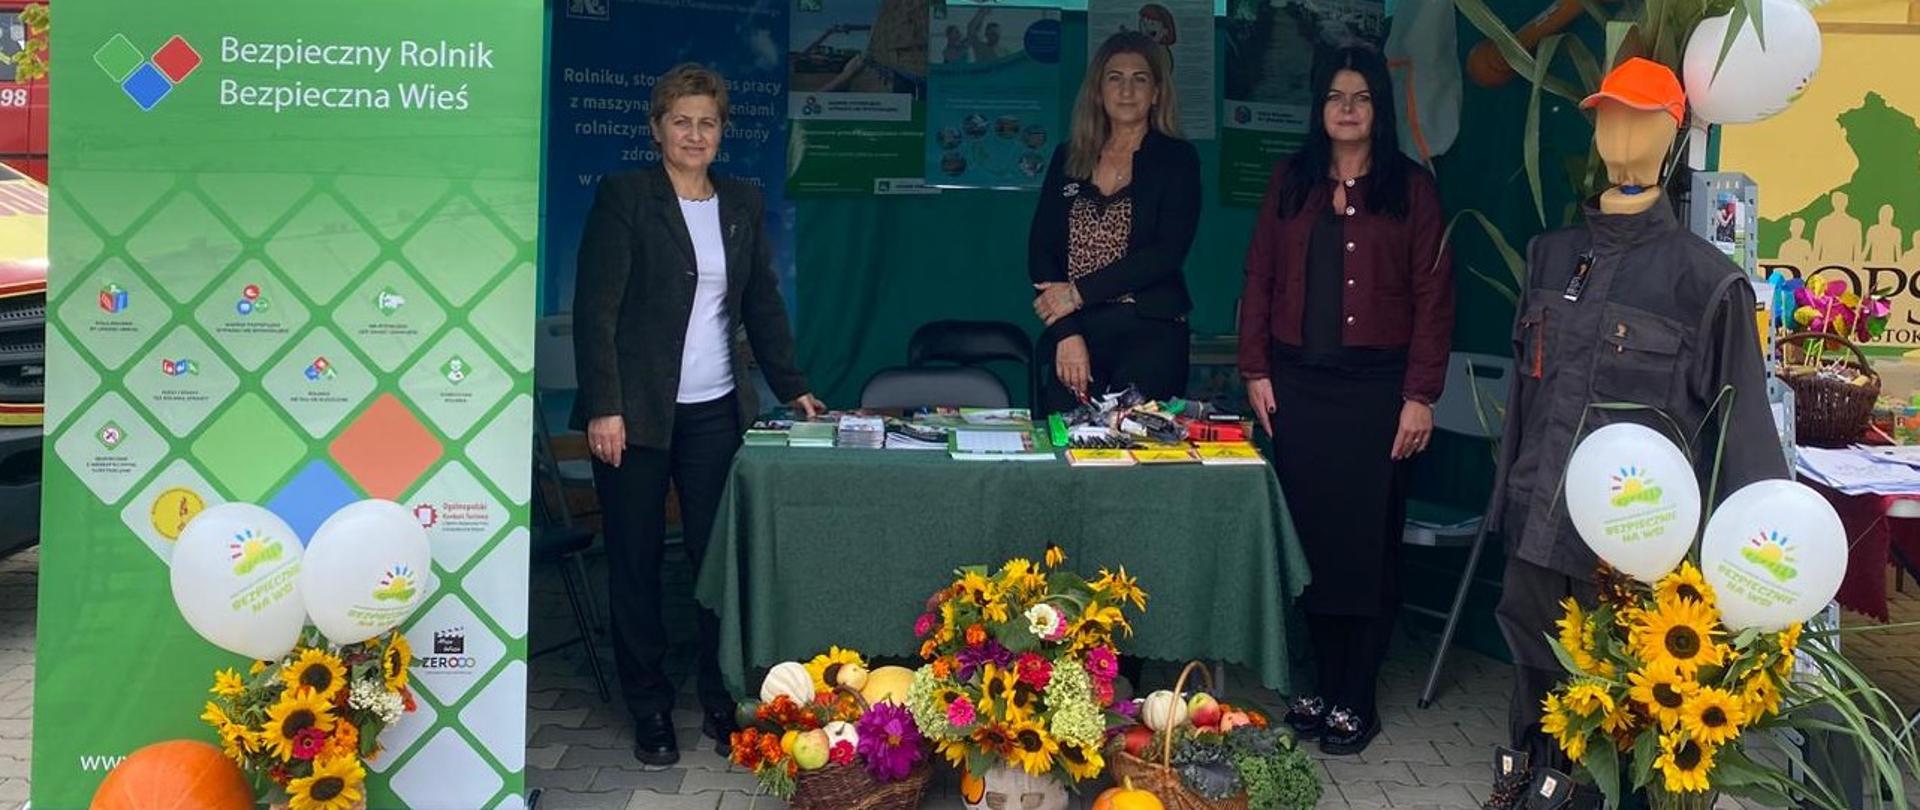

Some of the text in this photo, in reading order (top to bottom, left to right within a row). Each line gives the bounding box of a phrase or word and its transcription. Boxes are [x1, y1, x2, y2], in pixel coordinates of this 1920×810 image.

[220, 35, 495, 73] Bezpieczny Rolnik
[564, 67, 629, 88] Rolniku,
[742, 80, 782, 97] pracy
[219, 78, 470, 114] Bezpieczna Wieś
